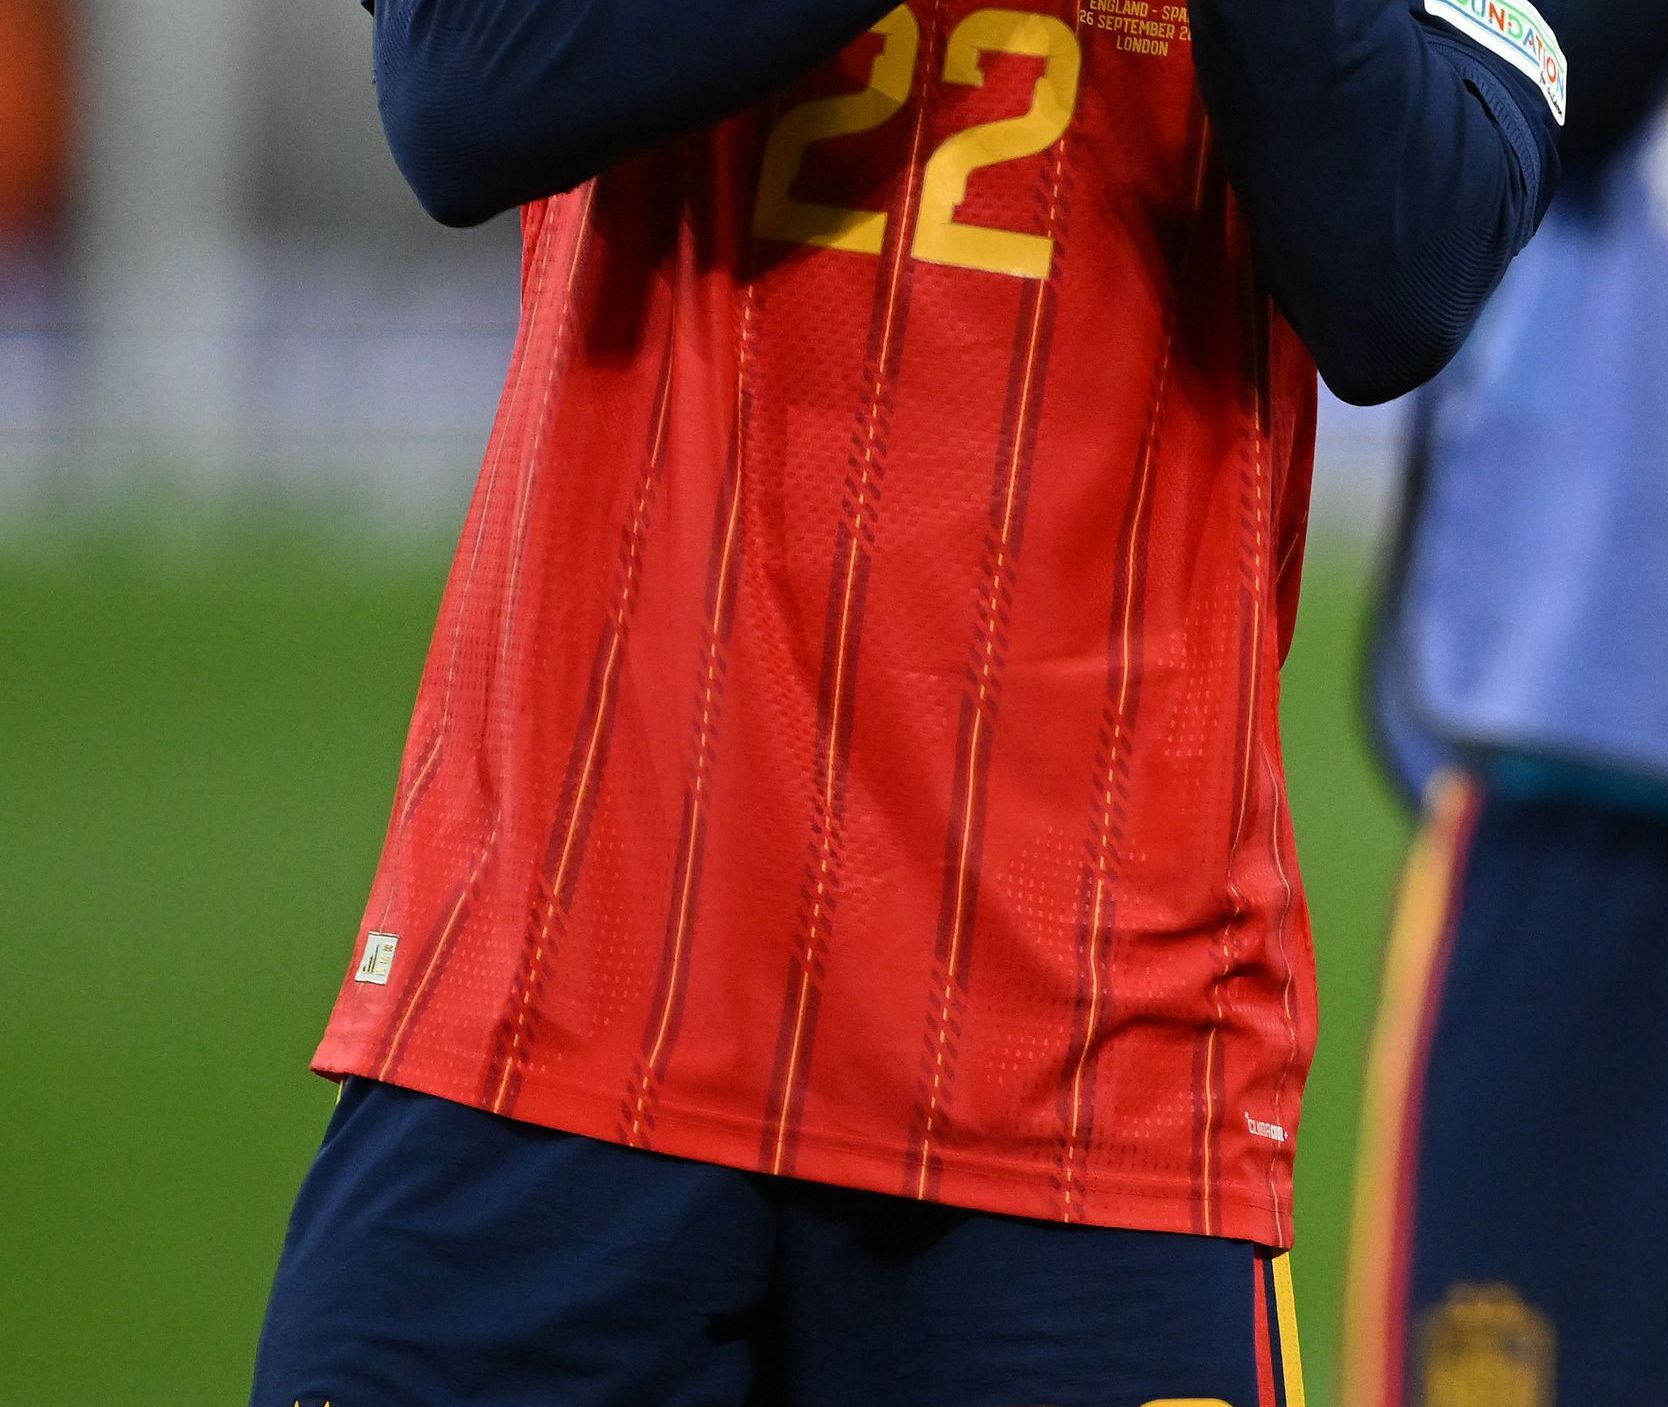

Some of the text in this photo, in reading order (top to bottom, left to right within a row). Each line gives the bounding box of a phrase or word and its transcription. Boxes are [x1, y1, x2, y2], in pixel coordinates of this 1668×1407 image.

[1079, 10, 1094, 26] 26
[1097, 15, 1175, 40] SEPTEMBER
[1116, 34, 1169, 57] LONDON
[750, 3, 1081, 281] 22
